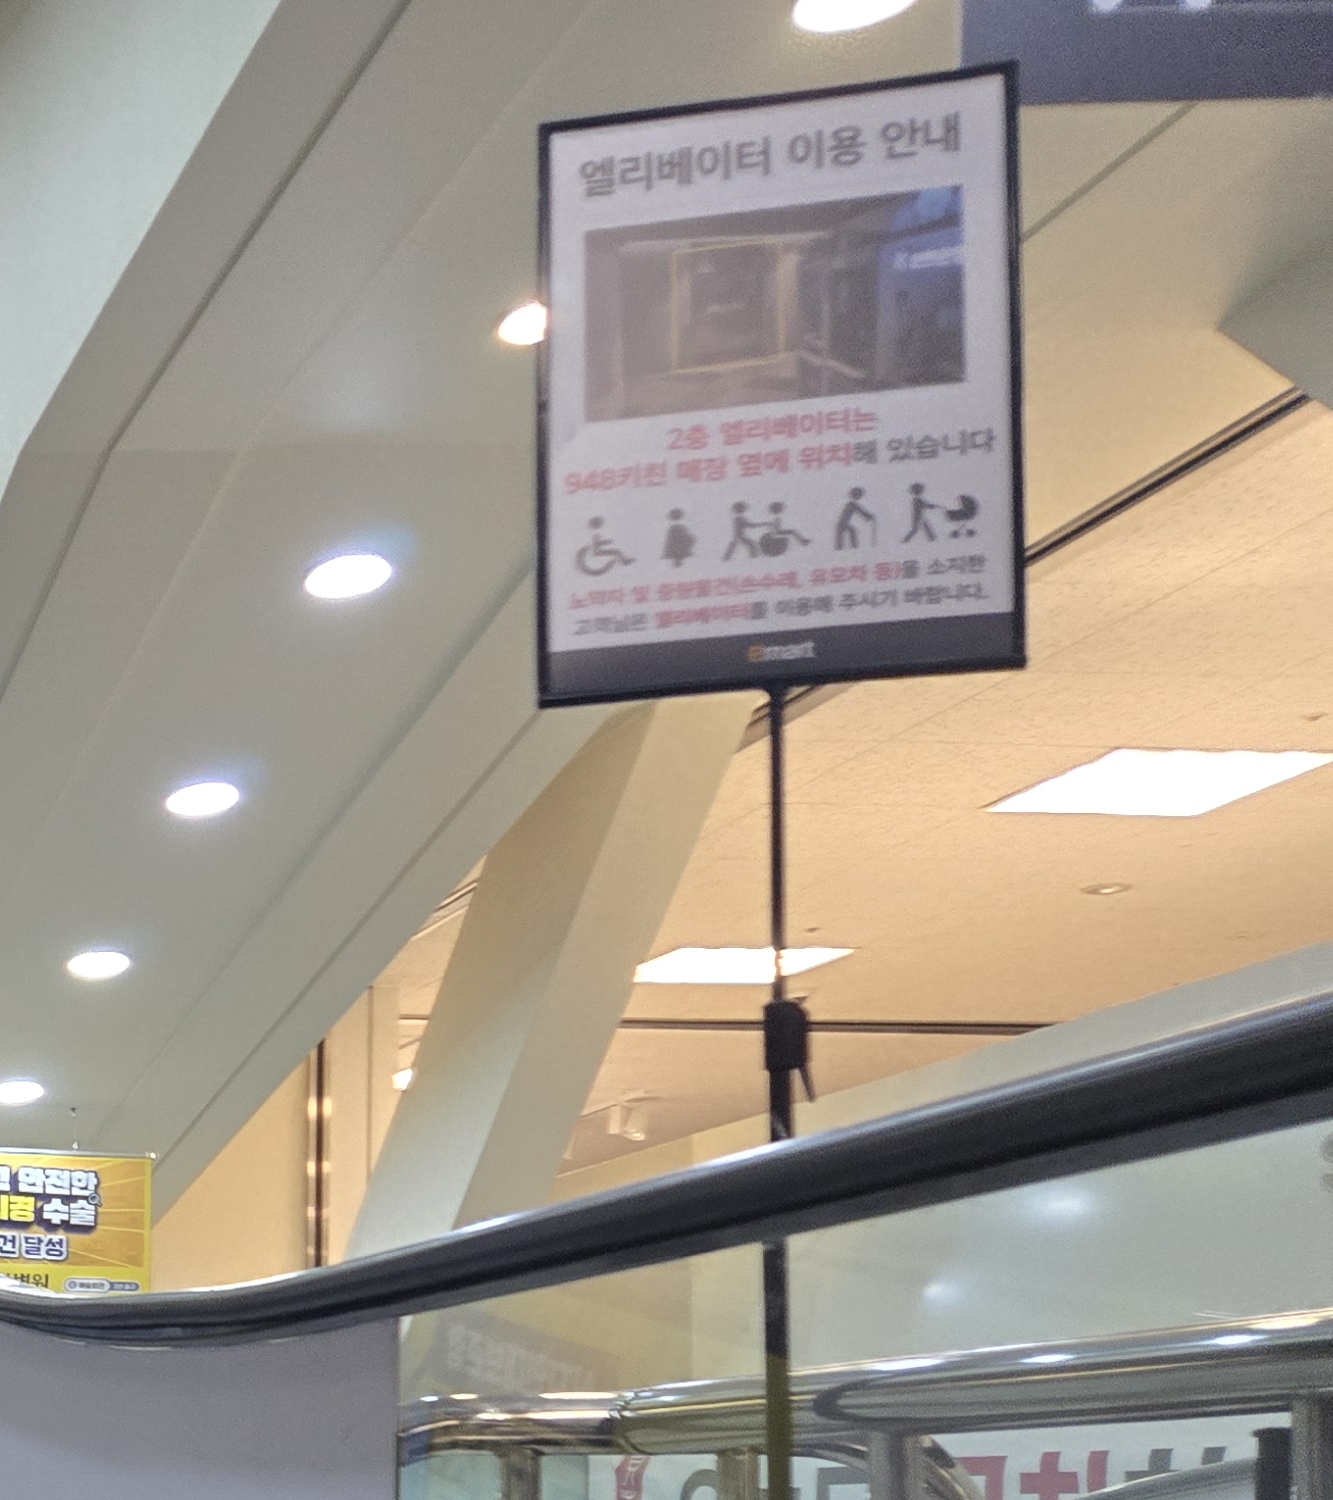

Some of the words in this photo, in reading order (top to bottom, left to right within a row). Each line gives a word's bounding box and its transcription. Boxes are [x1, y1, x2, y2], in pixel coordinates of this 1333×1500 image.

[578, 136, 772, 197] 엘리베이터
[788, 123, 867, 168] 이용
[879, 111, 961, 161] 안내
[666, 425, 710, 452] 2층
[719, 407, 879, 447] 엘리베이터는
[799, 434, 879, 471] 위치해
[17, 1165, 98, 1196] 안전한
[42, 1198, 97, 1226] 수술
[24, 1234, 66, 1258] 달성
